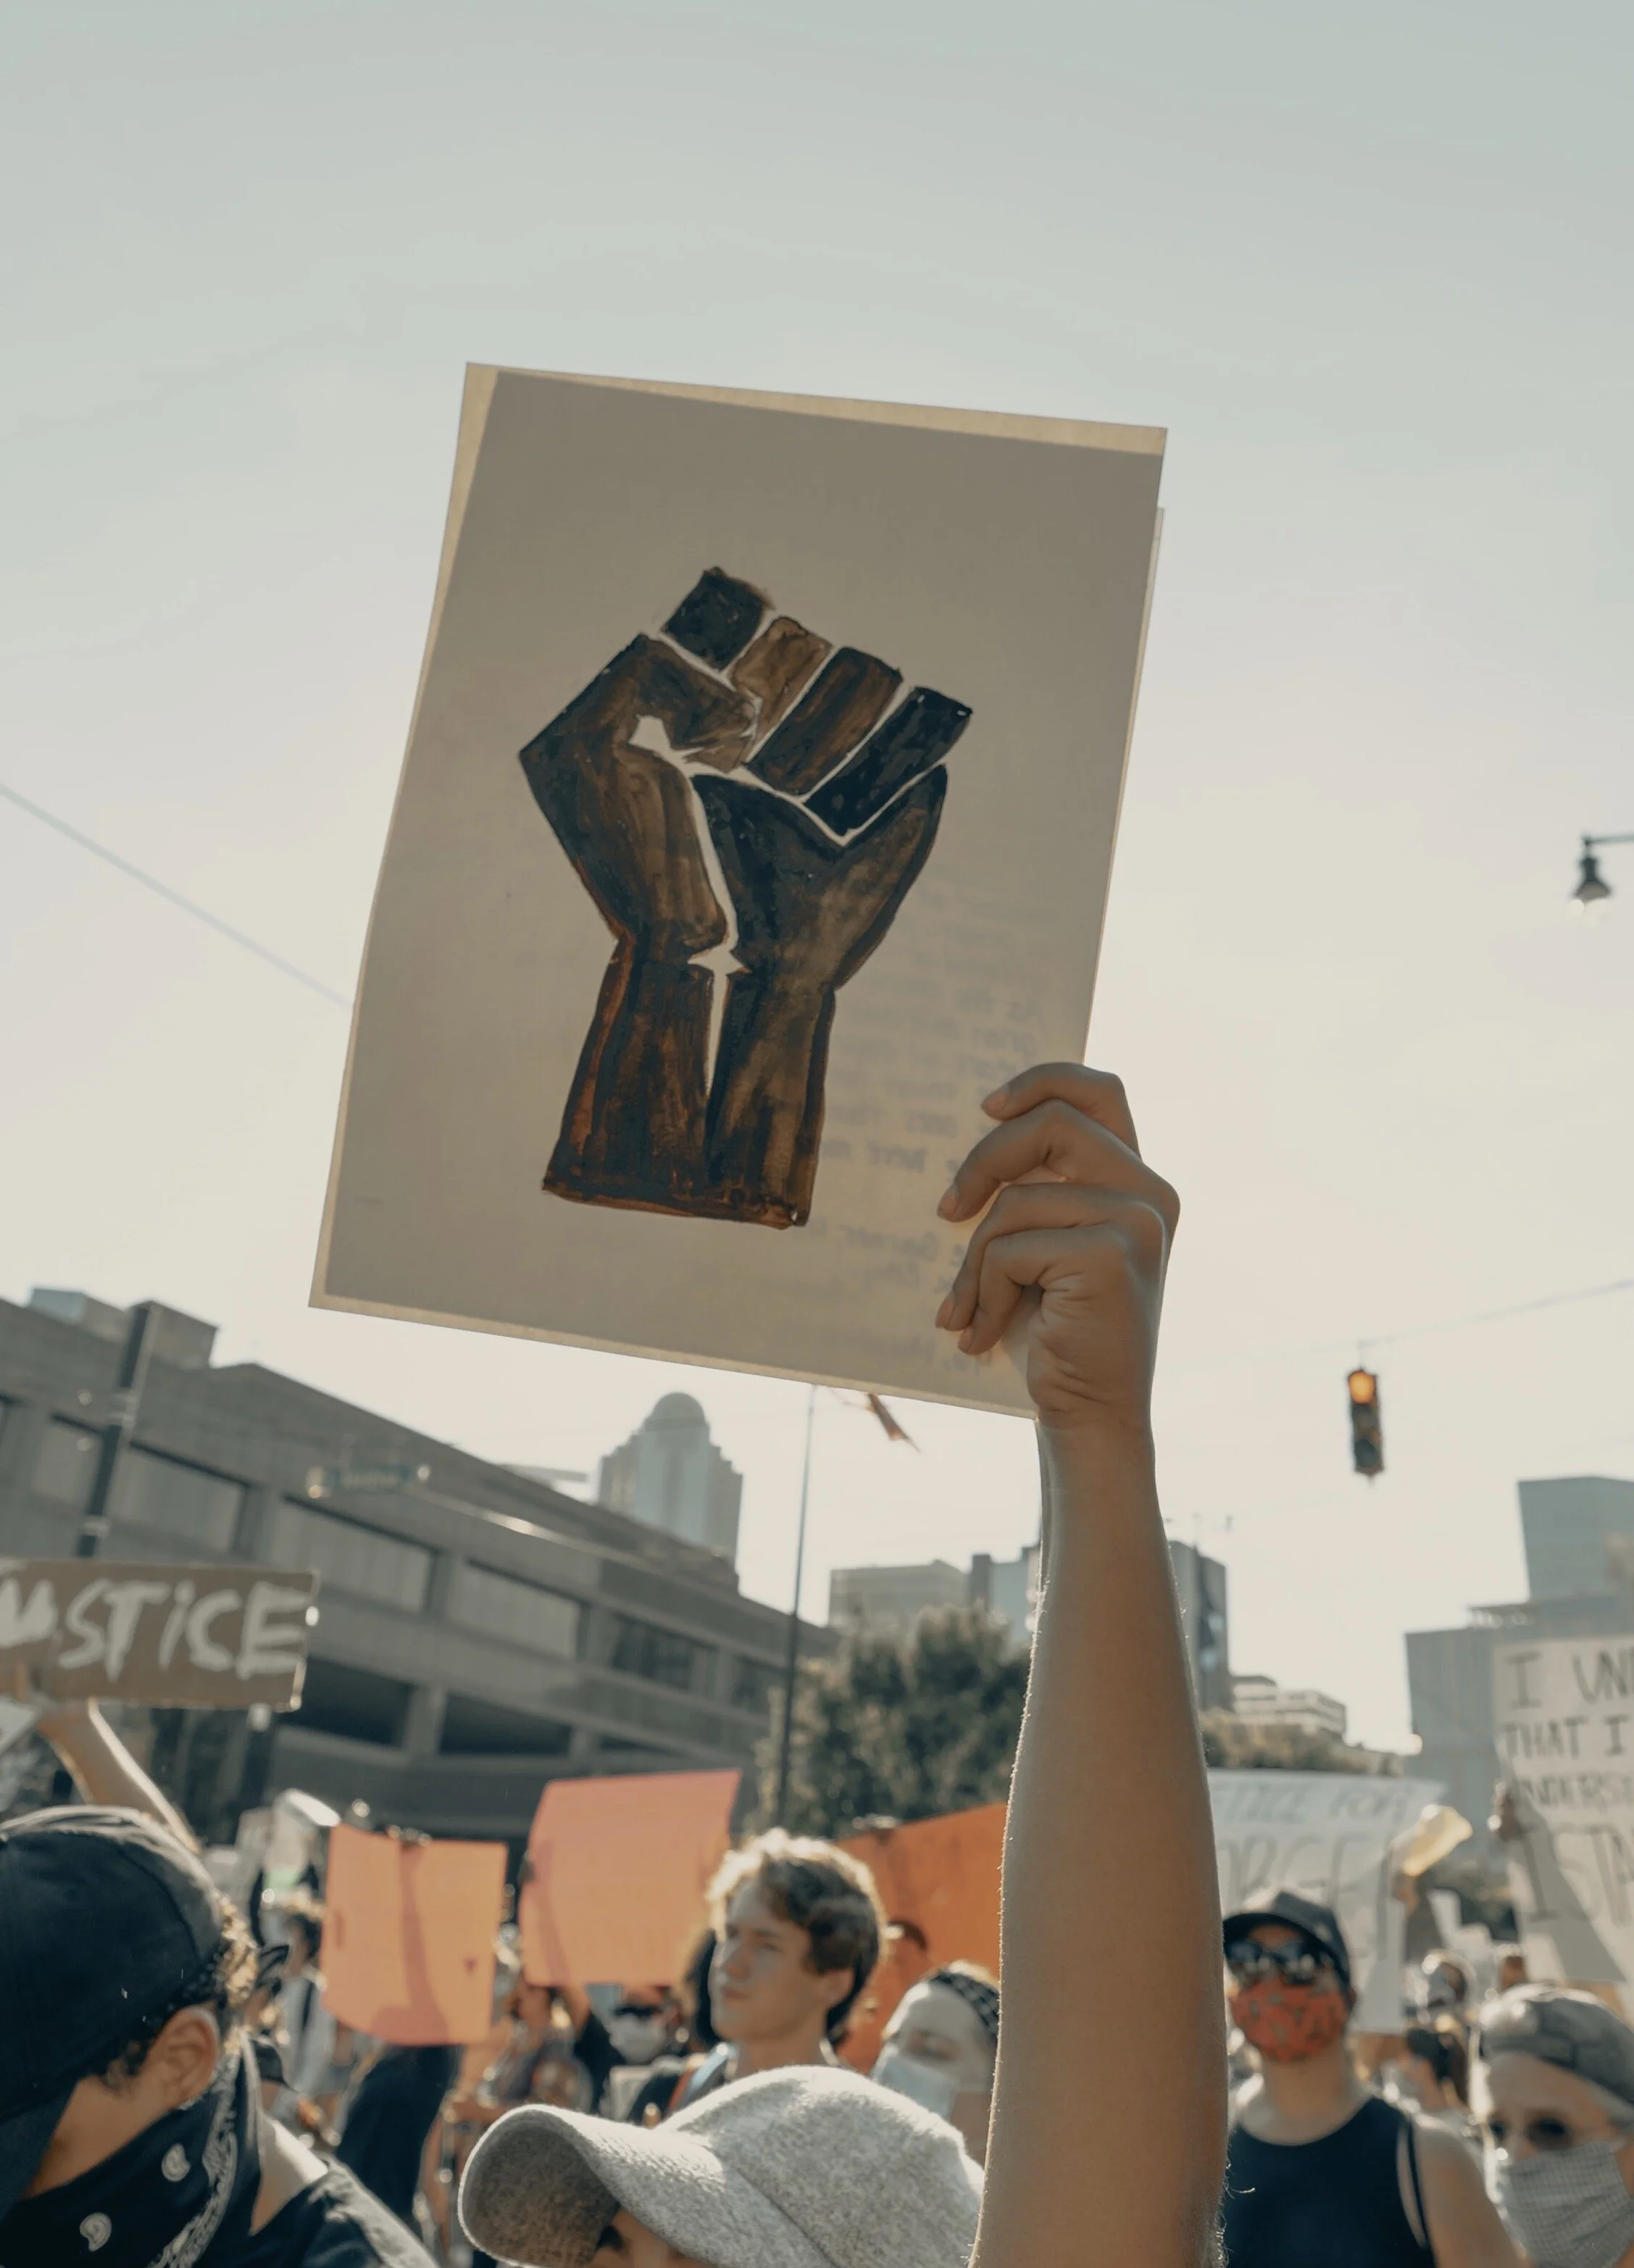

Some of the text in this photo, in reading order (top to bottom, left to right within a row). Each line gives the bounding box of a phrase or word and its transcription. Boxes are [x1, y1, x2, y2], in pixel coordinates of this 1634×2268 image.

[1507, 1647, 1634, 1709] I UN
[1505, 1713, 1630, 1760] THAT I
